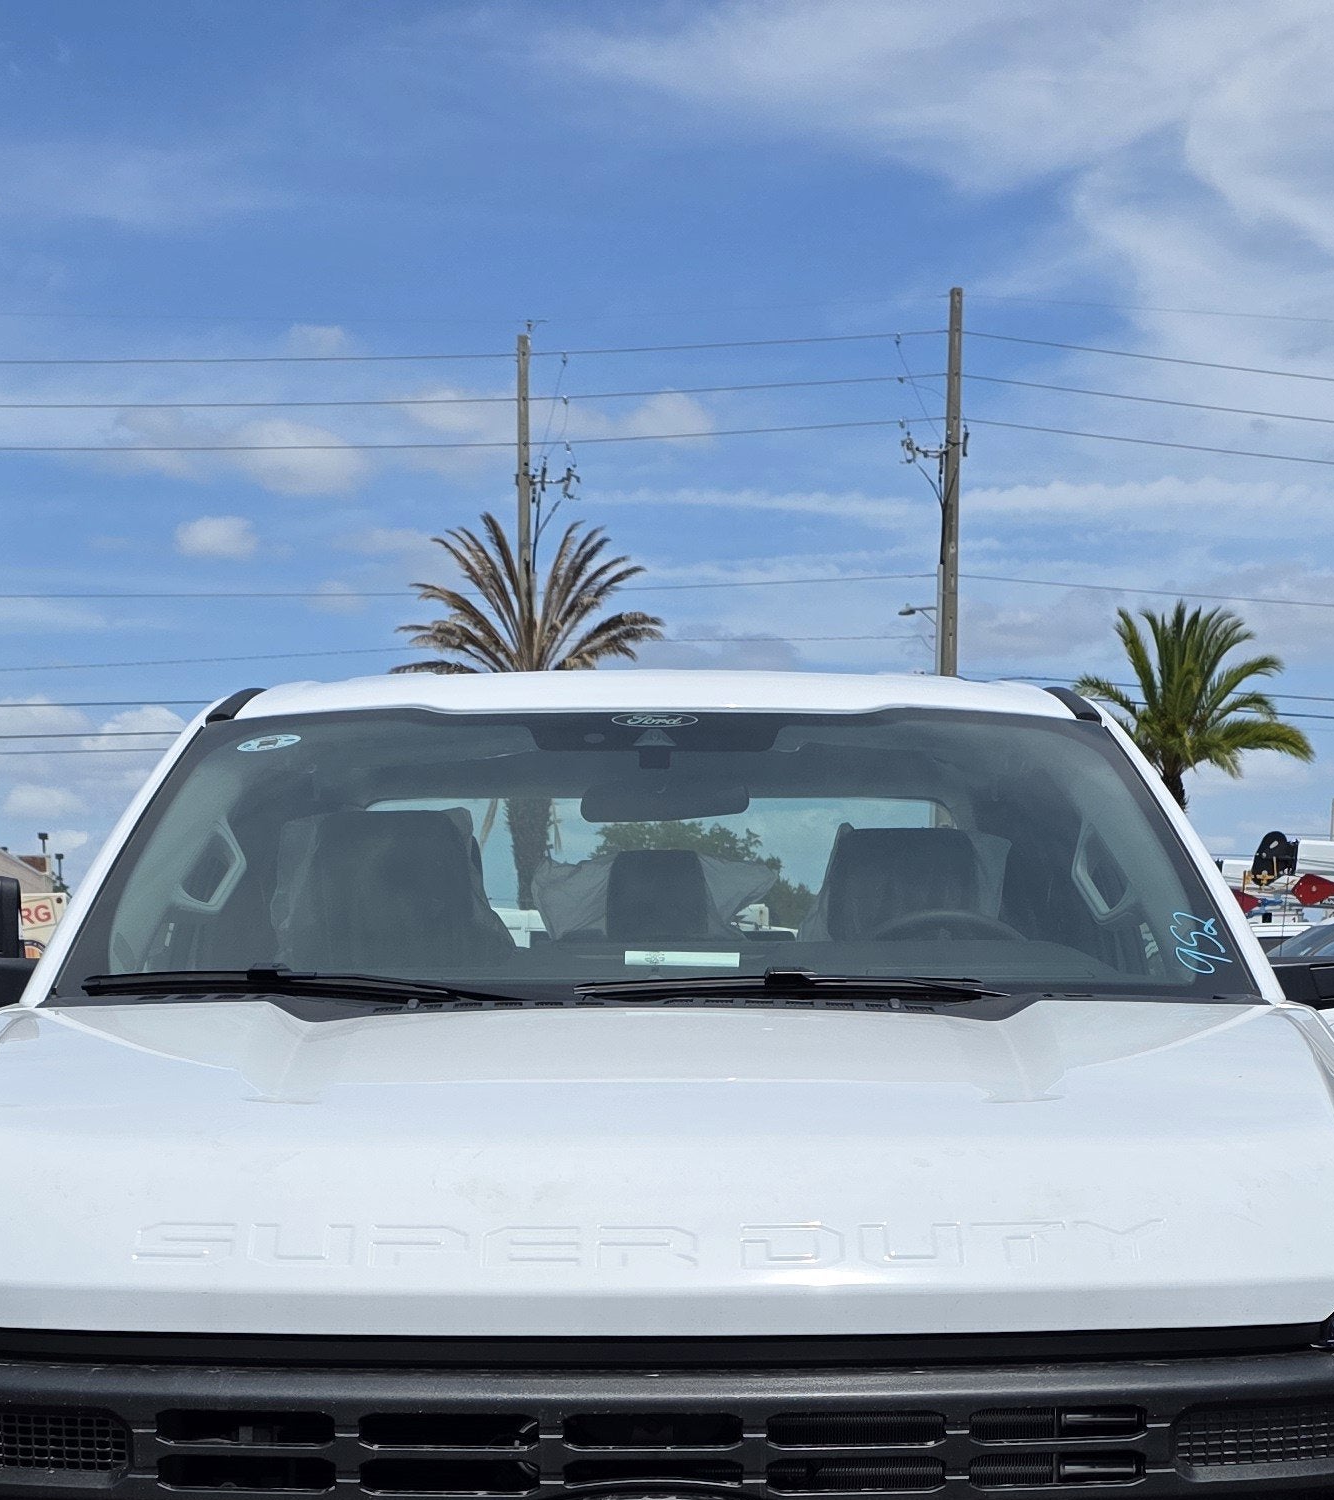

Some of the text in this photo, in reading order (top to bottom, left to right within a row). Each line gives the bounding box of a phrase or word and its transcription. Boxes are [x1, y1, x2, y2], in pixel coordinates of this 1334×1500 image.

[627, 714, 683, 725] Ford
[131, 1217, 1167, 1269] SUPER DUTY
